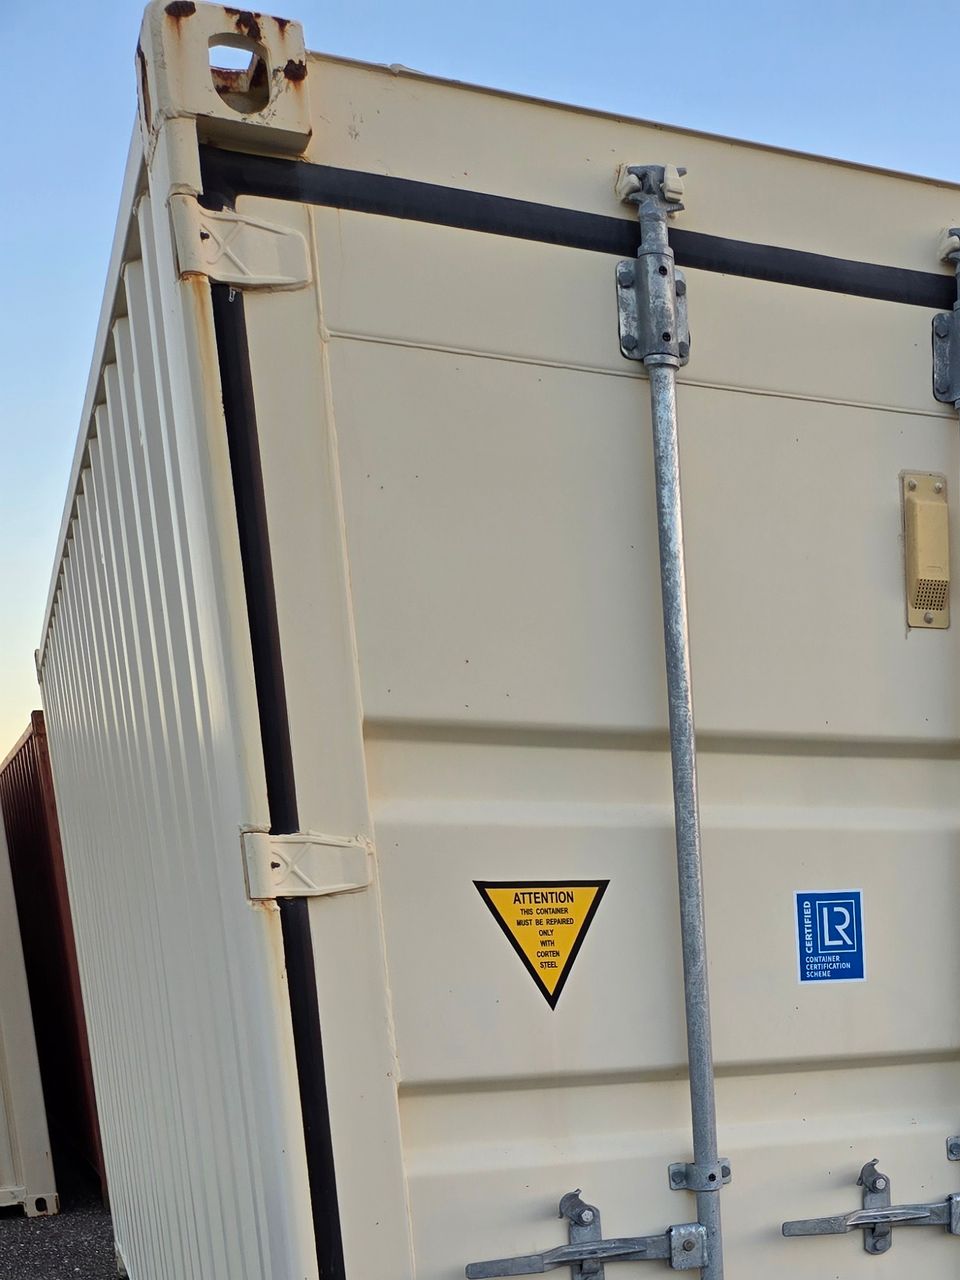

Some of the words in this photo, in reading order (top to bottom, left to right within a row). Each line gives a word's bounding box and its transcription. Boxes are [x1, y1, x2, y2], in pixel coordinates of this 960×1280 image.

[514, 892, 573, 904] ATTENTION
[546, 917, 574, 925] REPAIRED
[803, 900, 813, 954] CERTIFIED
[538, 929, 554, 937] ONLY
[536, 950, 560, 958] CORTEN
[805, 955, 840, 963] CONTAINER
[540, 961, 558, 969] STEEL
[806, 962, 851, 970] CERTIFICATION
[806, 970, 831, 978] SCHEME
